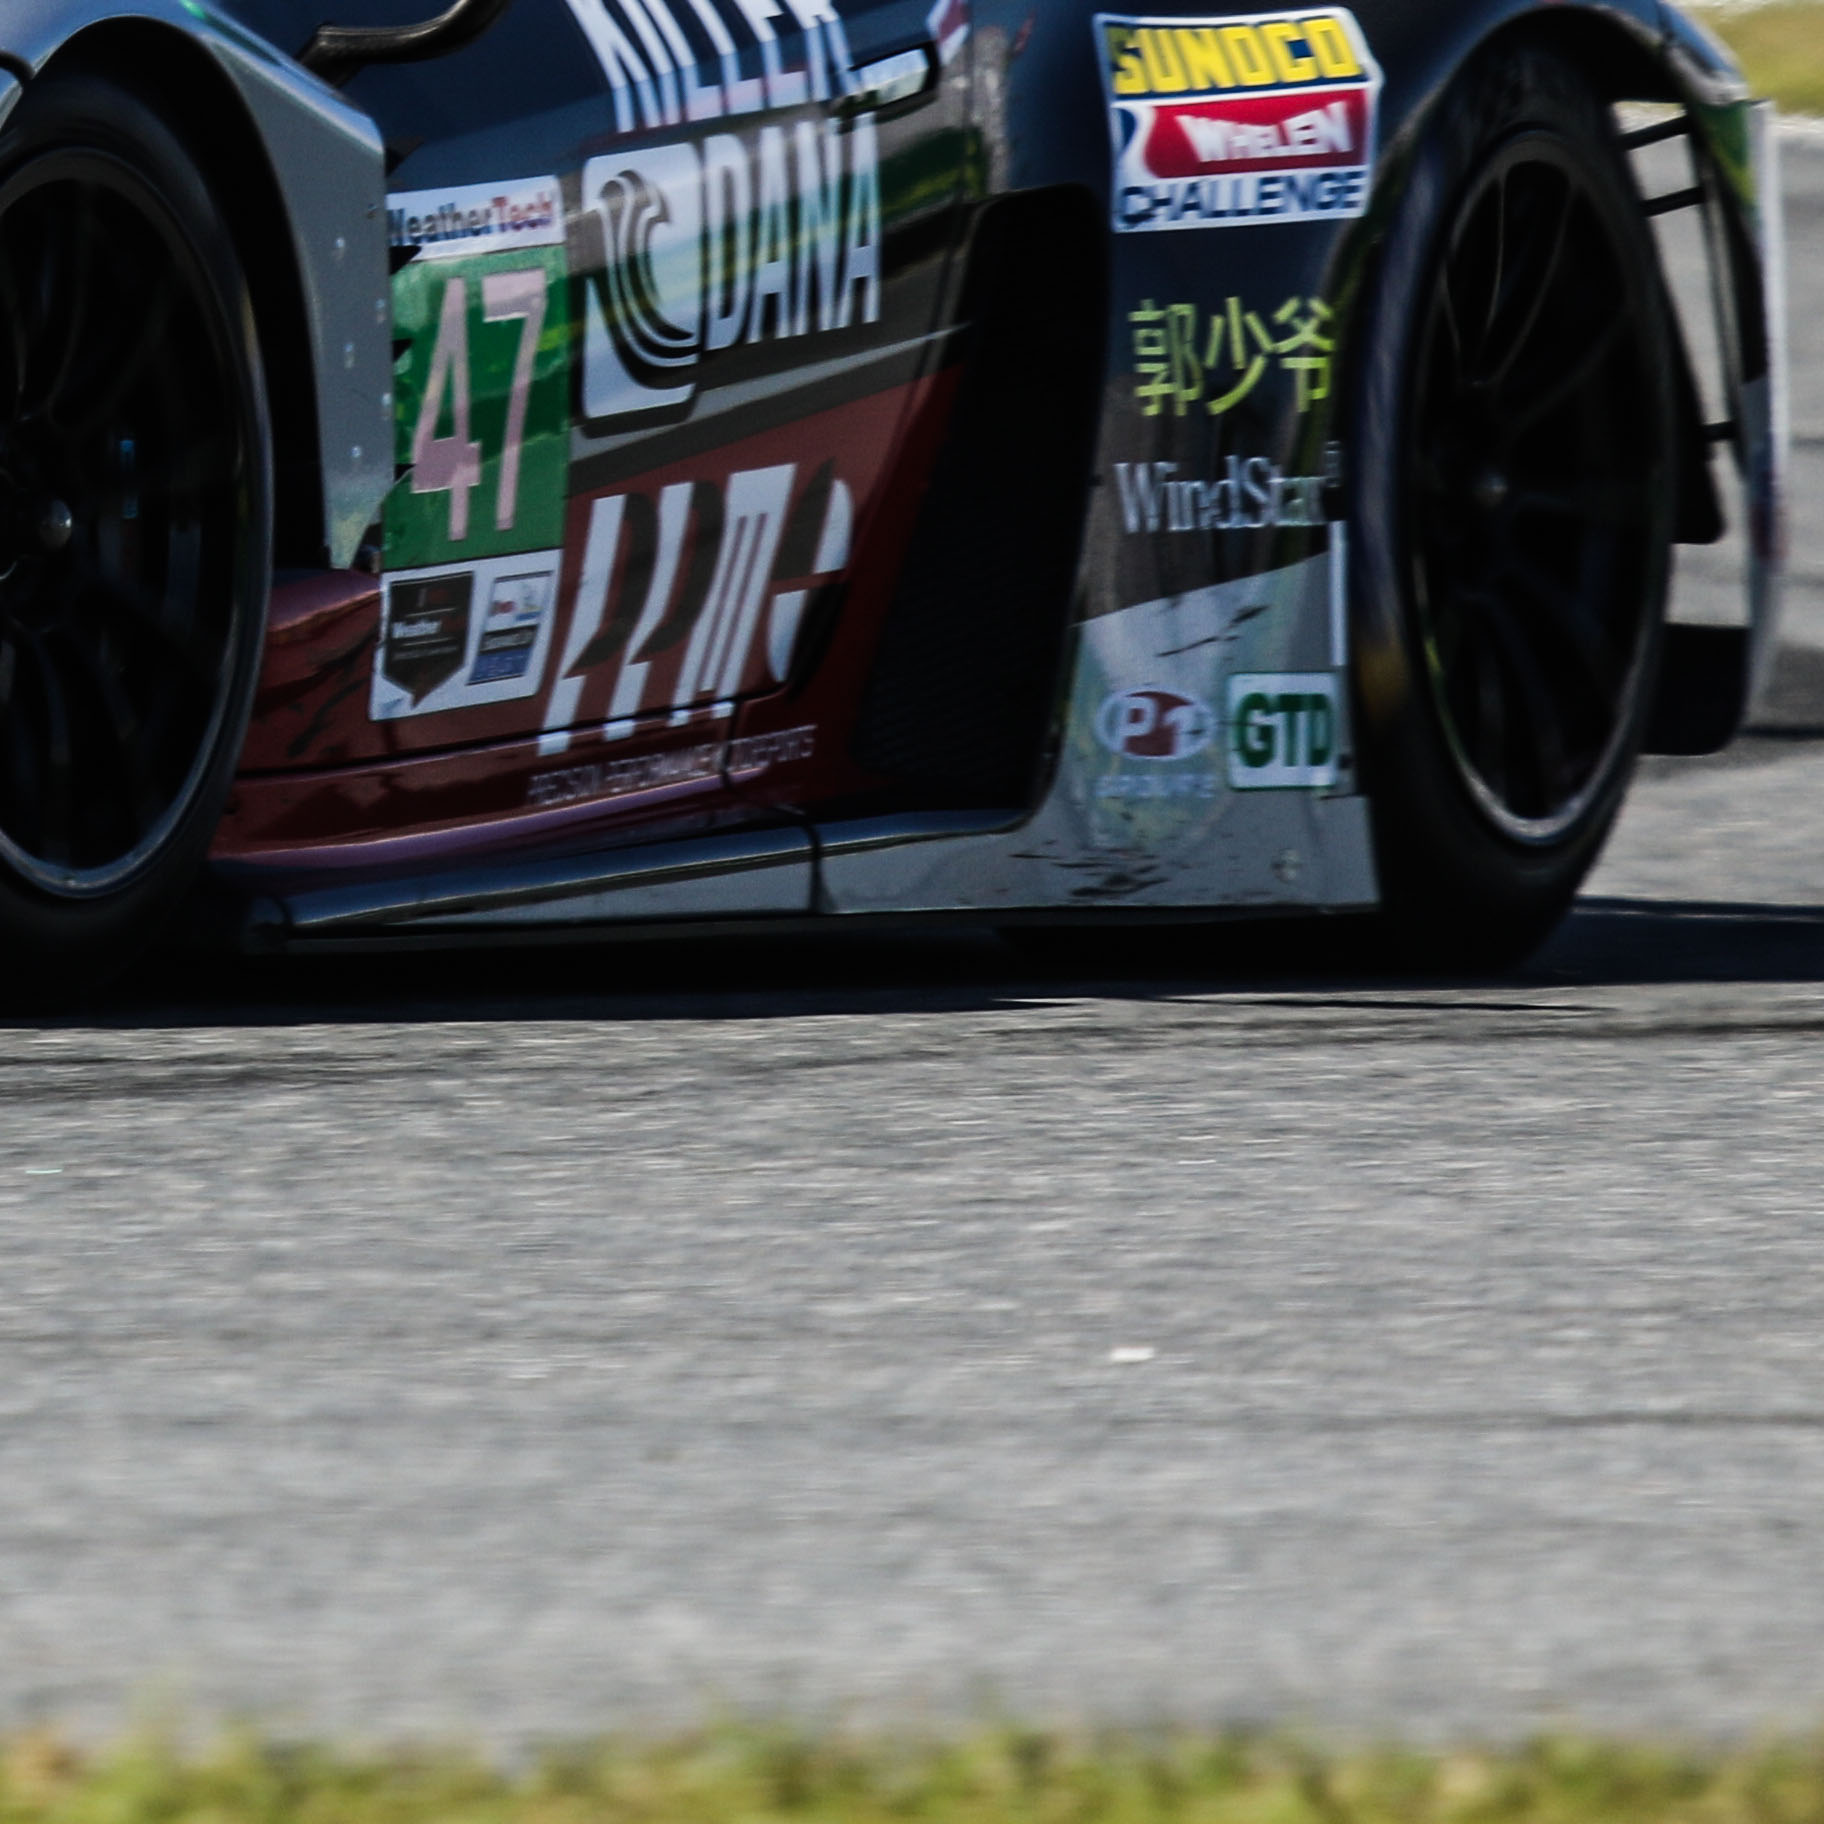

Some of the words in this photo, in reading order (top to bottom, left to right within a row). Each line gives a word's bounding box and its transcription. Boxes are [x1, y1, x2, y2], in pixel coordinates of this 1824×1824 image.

[1109, 17, 1363, 94] SUNOCO
[1178, 100, 1352, 163] WHELEN
[703, 108, 882, 351] DANA
[1118, 170, 1364, 226] CHALLENGE
[1129, 297, 1334, 417] 郭少爷
[412, 269, 546, 542] 47
[1114, 454, 1326, 533] WindStar
[1236, 691, 1332, 770] GTD
